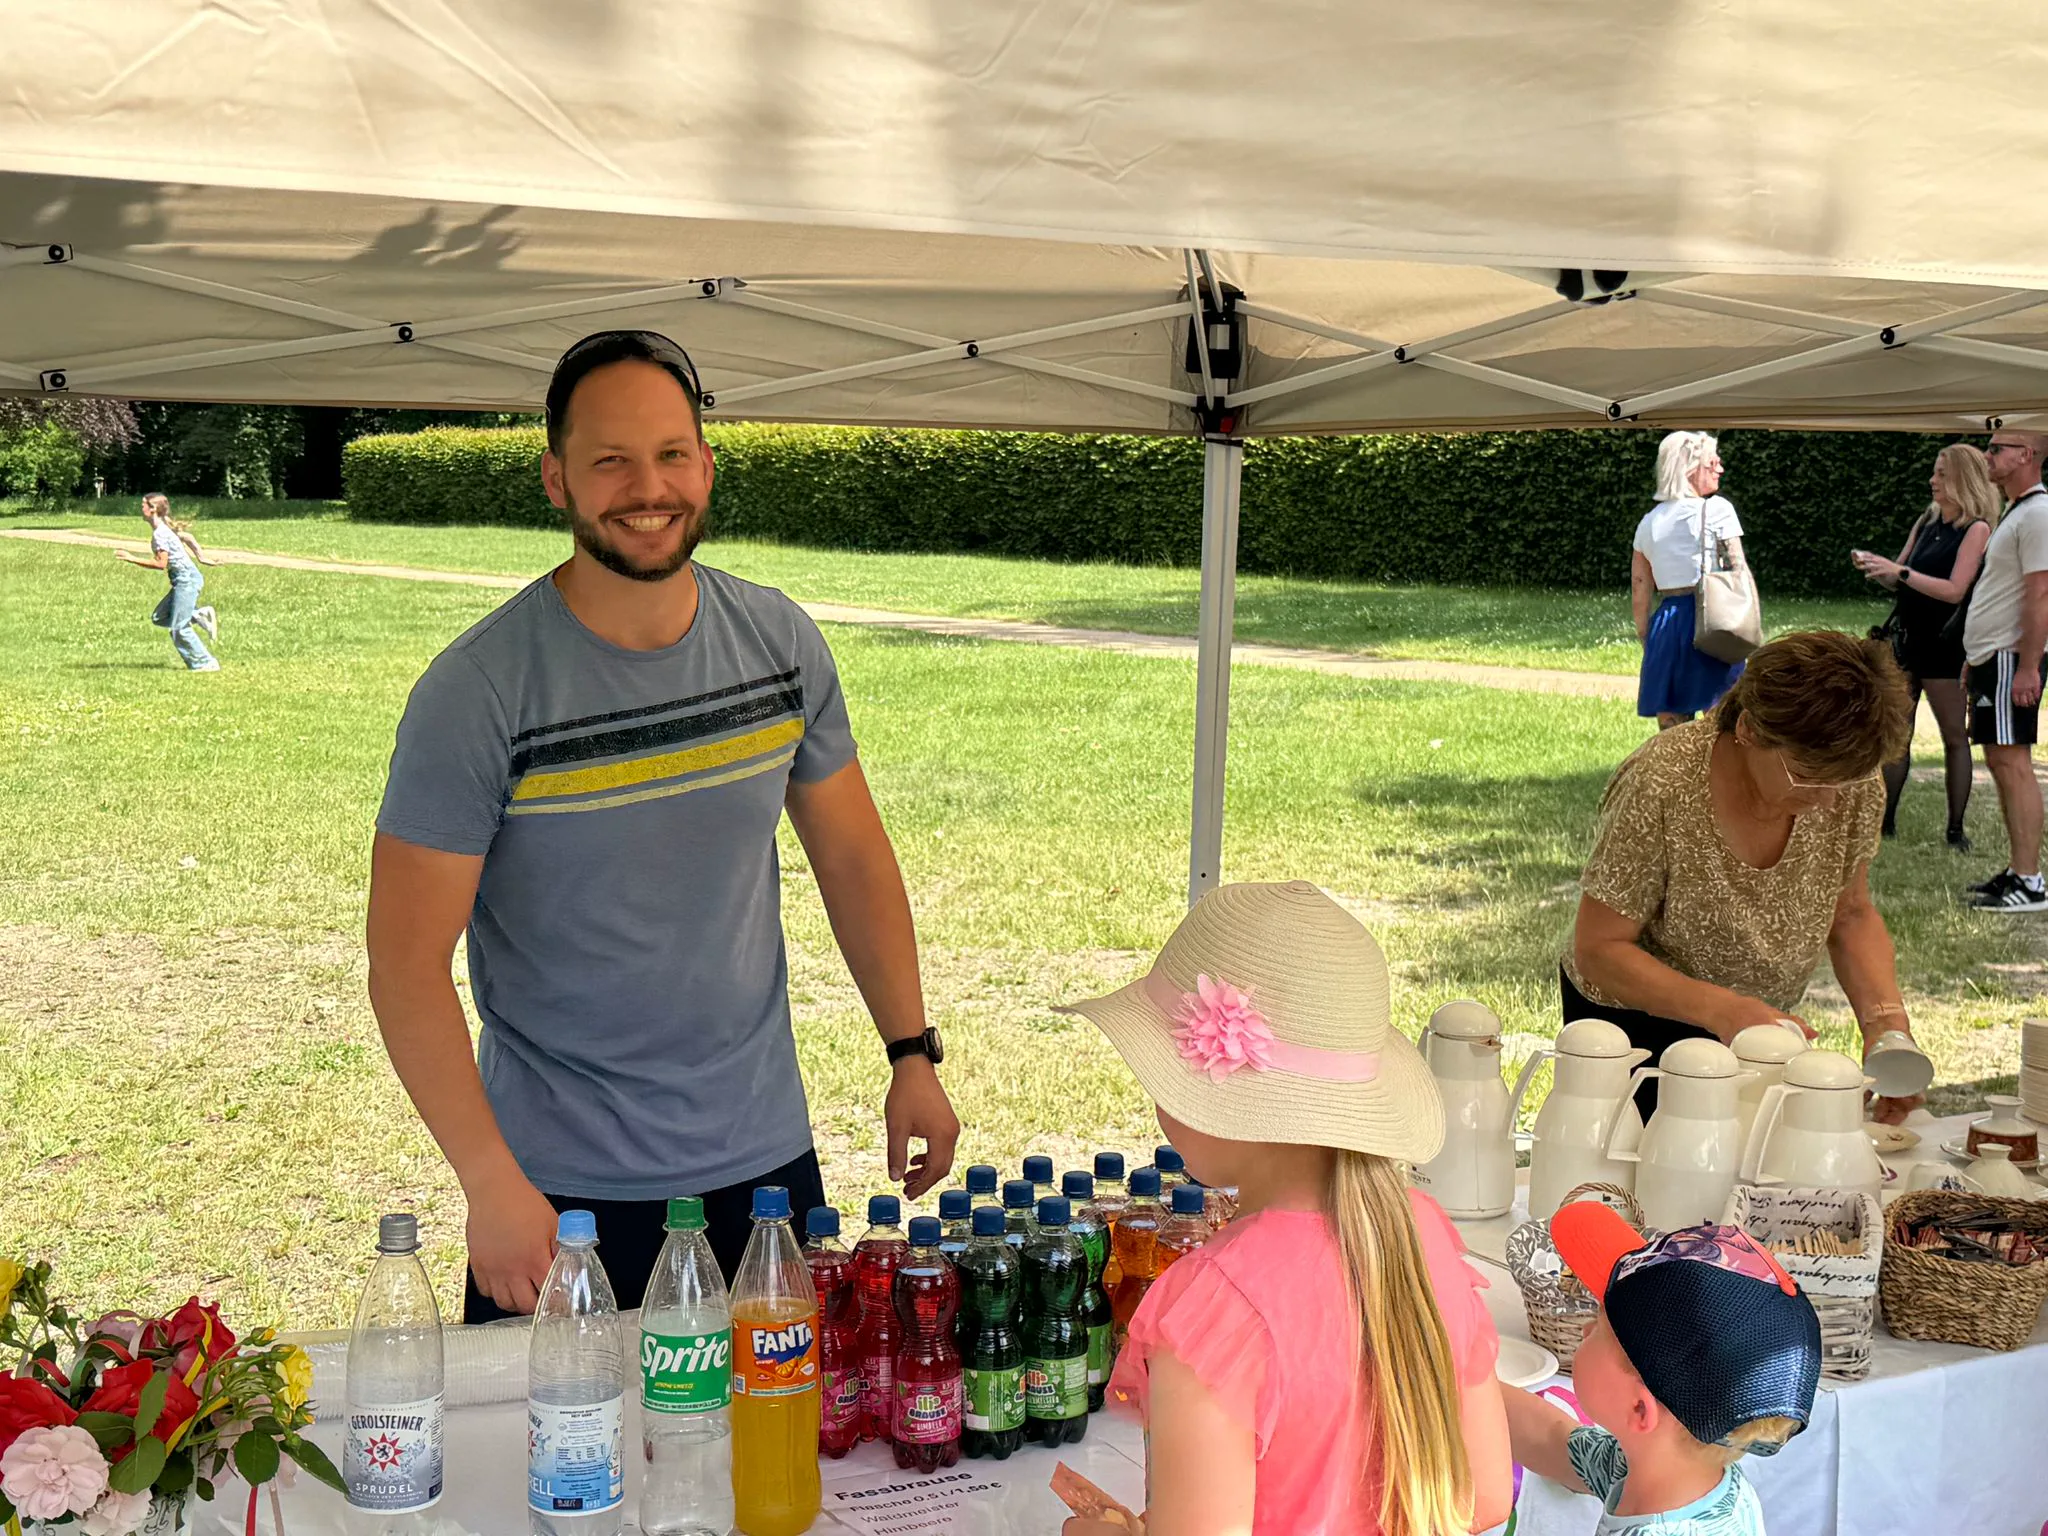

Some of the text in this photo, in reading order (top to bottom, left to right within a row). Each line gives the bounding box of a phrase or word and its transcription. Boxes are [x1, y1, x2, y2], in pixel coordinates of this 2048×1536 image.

[752, 1322, 813, 1355] FANTA
[641, 1335, 729, 1378] Sprite
[351, 1415, 423, 1431] GEROLSTEINER
[356, 1483, 413, 1494] SPRUDEL
[834, 1472, 973, 1501] Fassbrause
[849, 1499, 911, 1512] Flasche
[860, 1501, 960, 1523] Waldmeister
[873, 1516, 952, 1535] Himbeere
